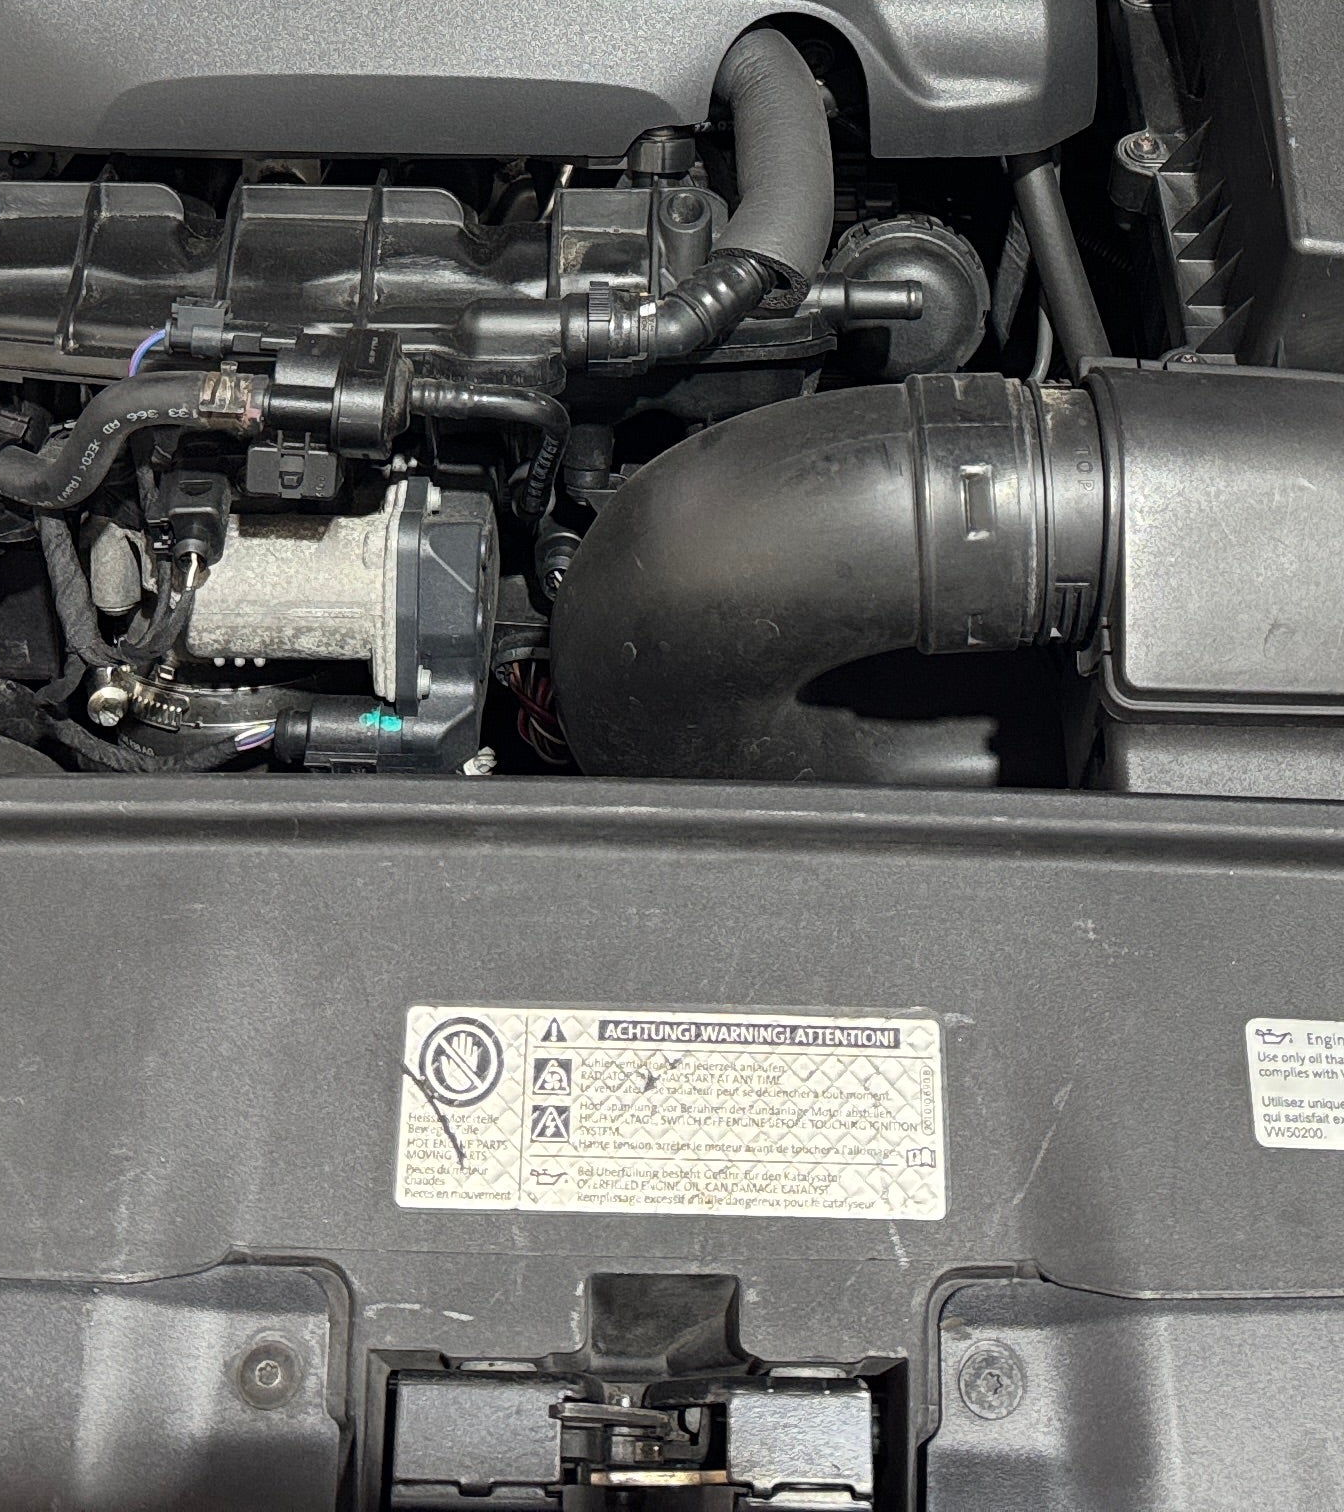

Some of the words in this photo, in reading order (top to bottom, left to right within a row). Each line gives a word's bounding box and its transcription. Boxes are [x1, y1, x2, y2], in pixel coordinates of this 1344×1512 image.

[126, 409, 160, 422] 366
[102, 419, 121, 435] AD
[1072, 445, 1096, 492] TOP
[604, 1022, 696, 1041] ACHTUNG!
[699, 1024, 791, 1044] WARNING!
[794, 1027, 895, 1047] ATTENTION!
[1257, 1051, 1279, 1062] Use
[1281, 1052, 1306, 1066] only
[1308, 1053, 1322, 1064] oil
[684, 1073, 714, 1083] START
[717, 1074, 730, 1083] AT
[733, 1074, 753, 1085] ANY
[1259, 1067, 1310, 1081] complies
[1312, 1069, 1338, 1080] with
[1261, 1096, 1305, 1109] Utilisez
[1263, 1112, 1281, 1126] qui
[1284, 1112, 1330, 1124] satisfait
[407, 1138, 429, 1148] HOT
[476, 1140, 508, 1150] PARTS
[405, 1150, 452, 1160] MOVING
